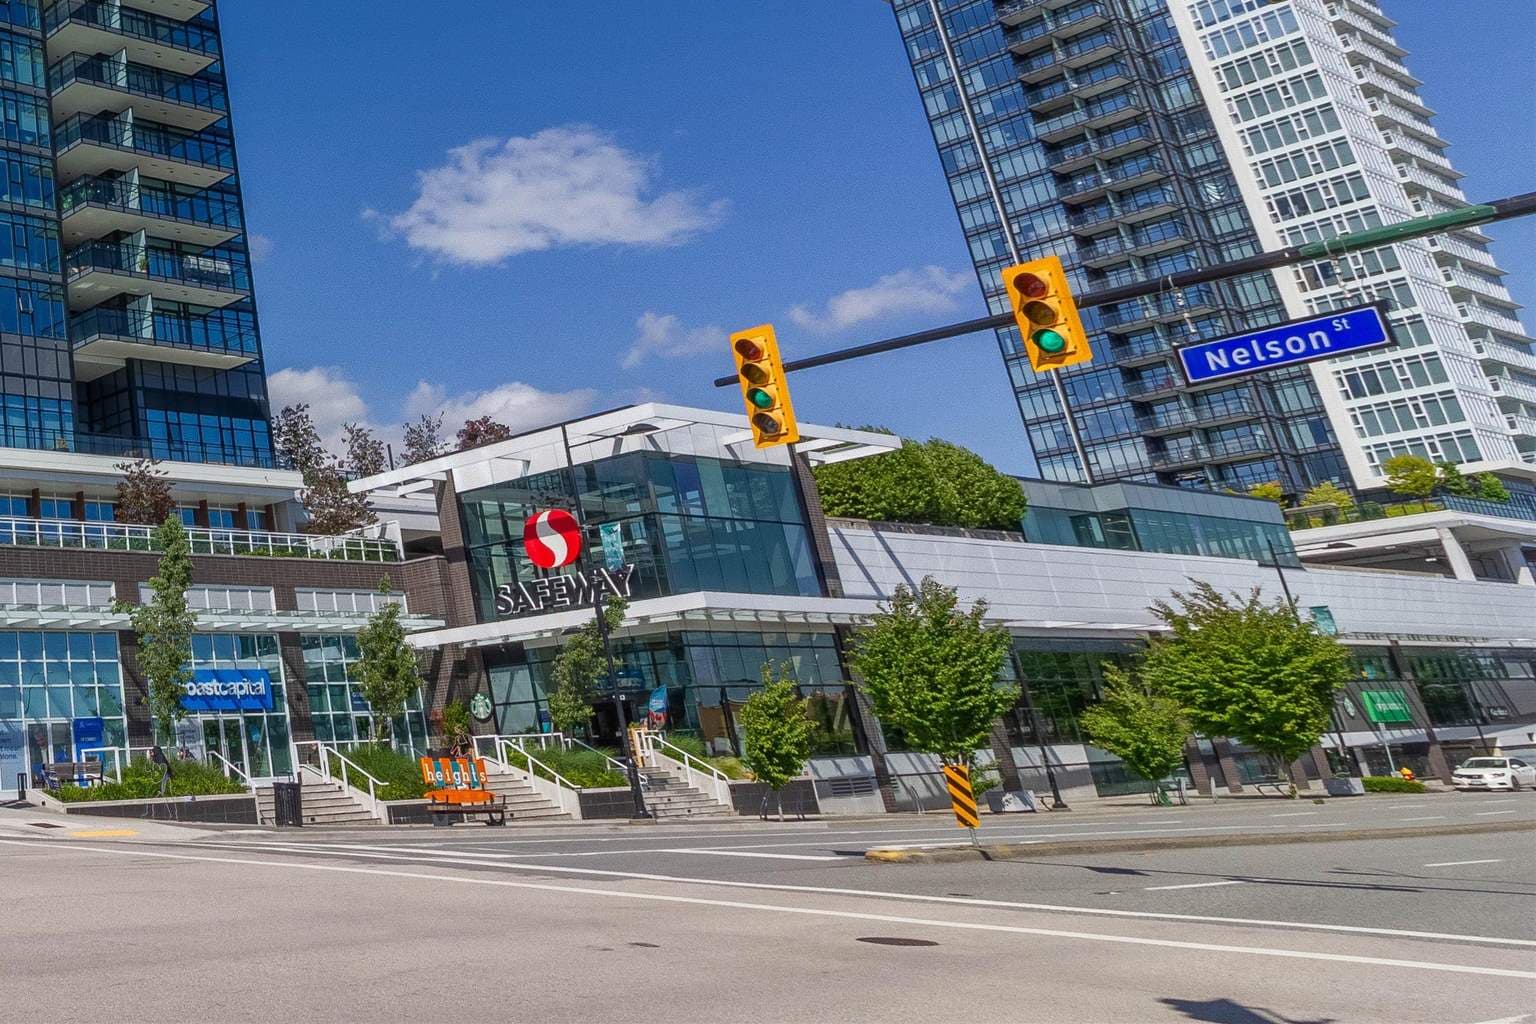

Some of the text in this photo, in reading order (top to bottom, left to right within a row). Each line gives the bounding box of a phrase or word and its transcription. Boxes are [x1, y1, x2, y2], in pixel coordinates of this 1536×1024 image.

[1205, 317, 1351, 372] Nelson St
[496, 563, 635, 616] SAFEWAY
[180, 677, 265, 699] oastcapital
[424, 763, 486, 785] heights
